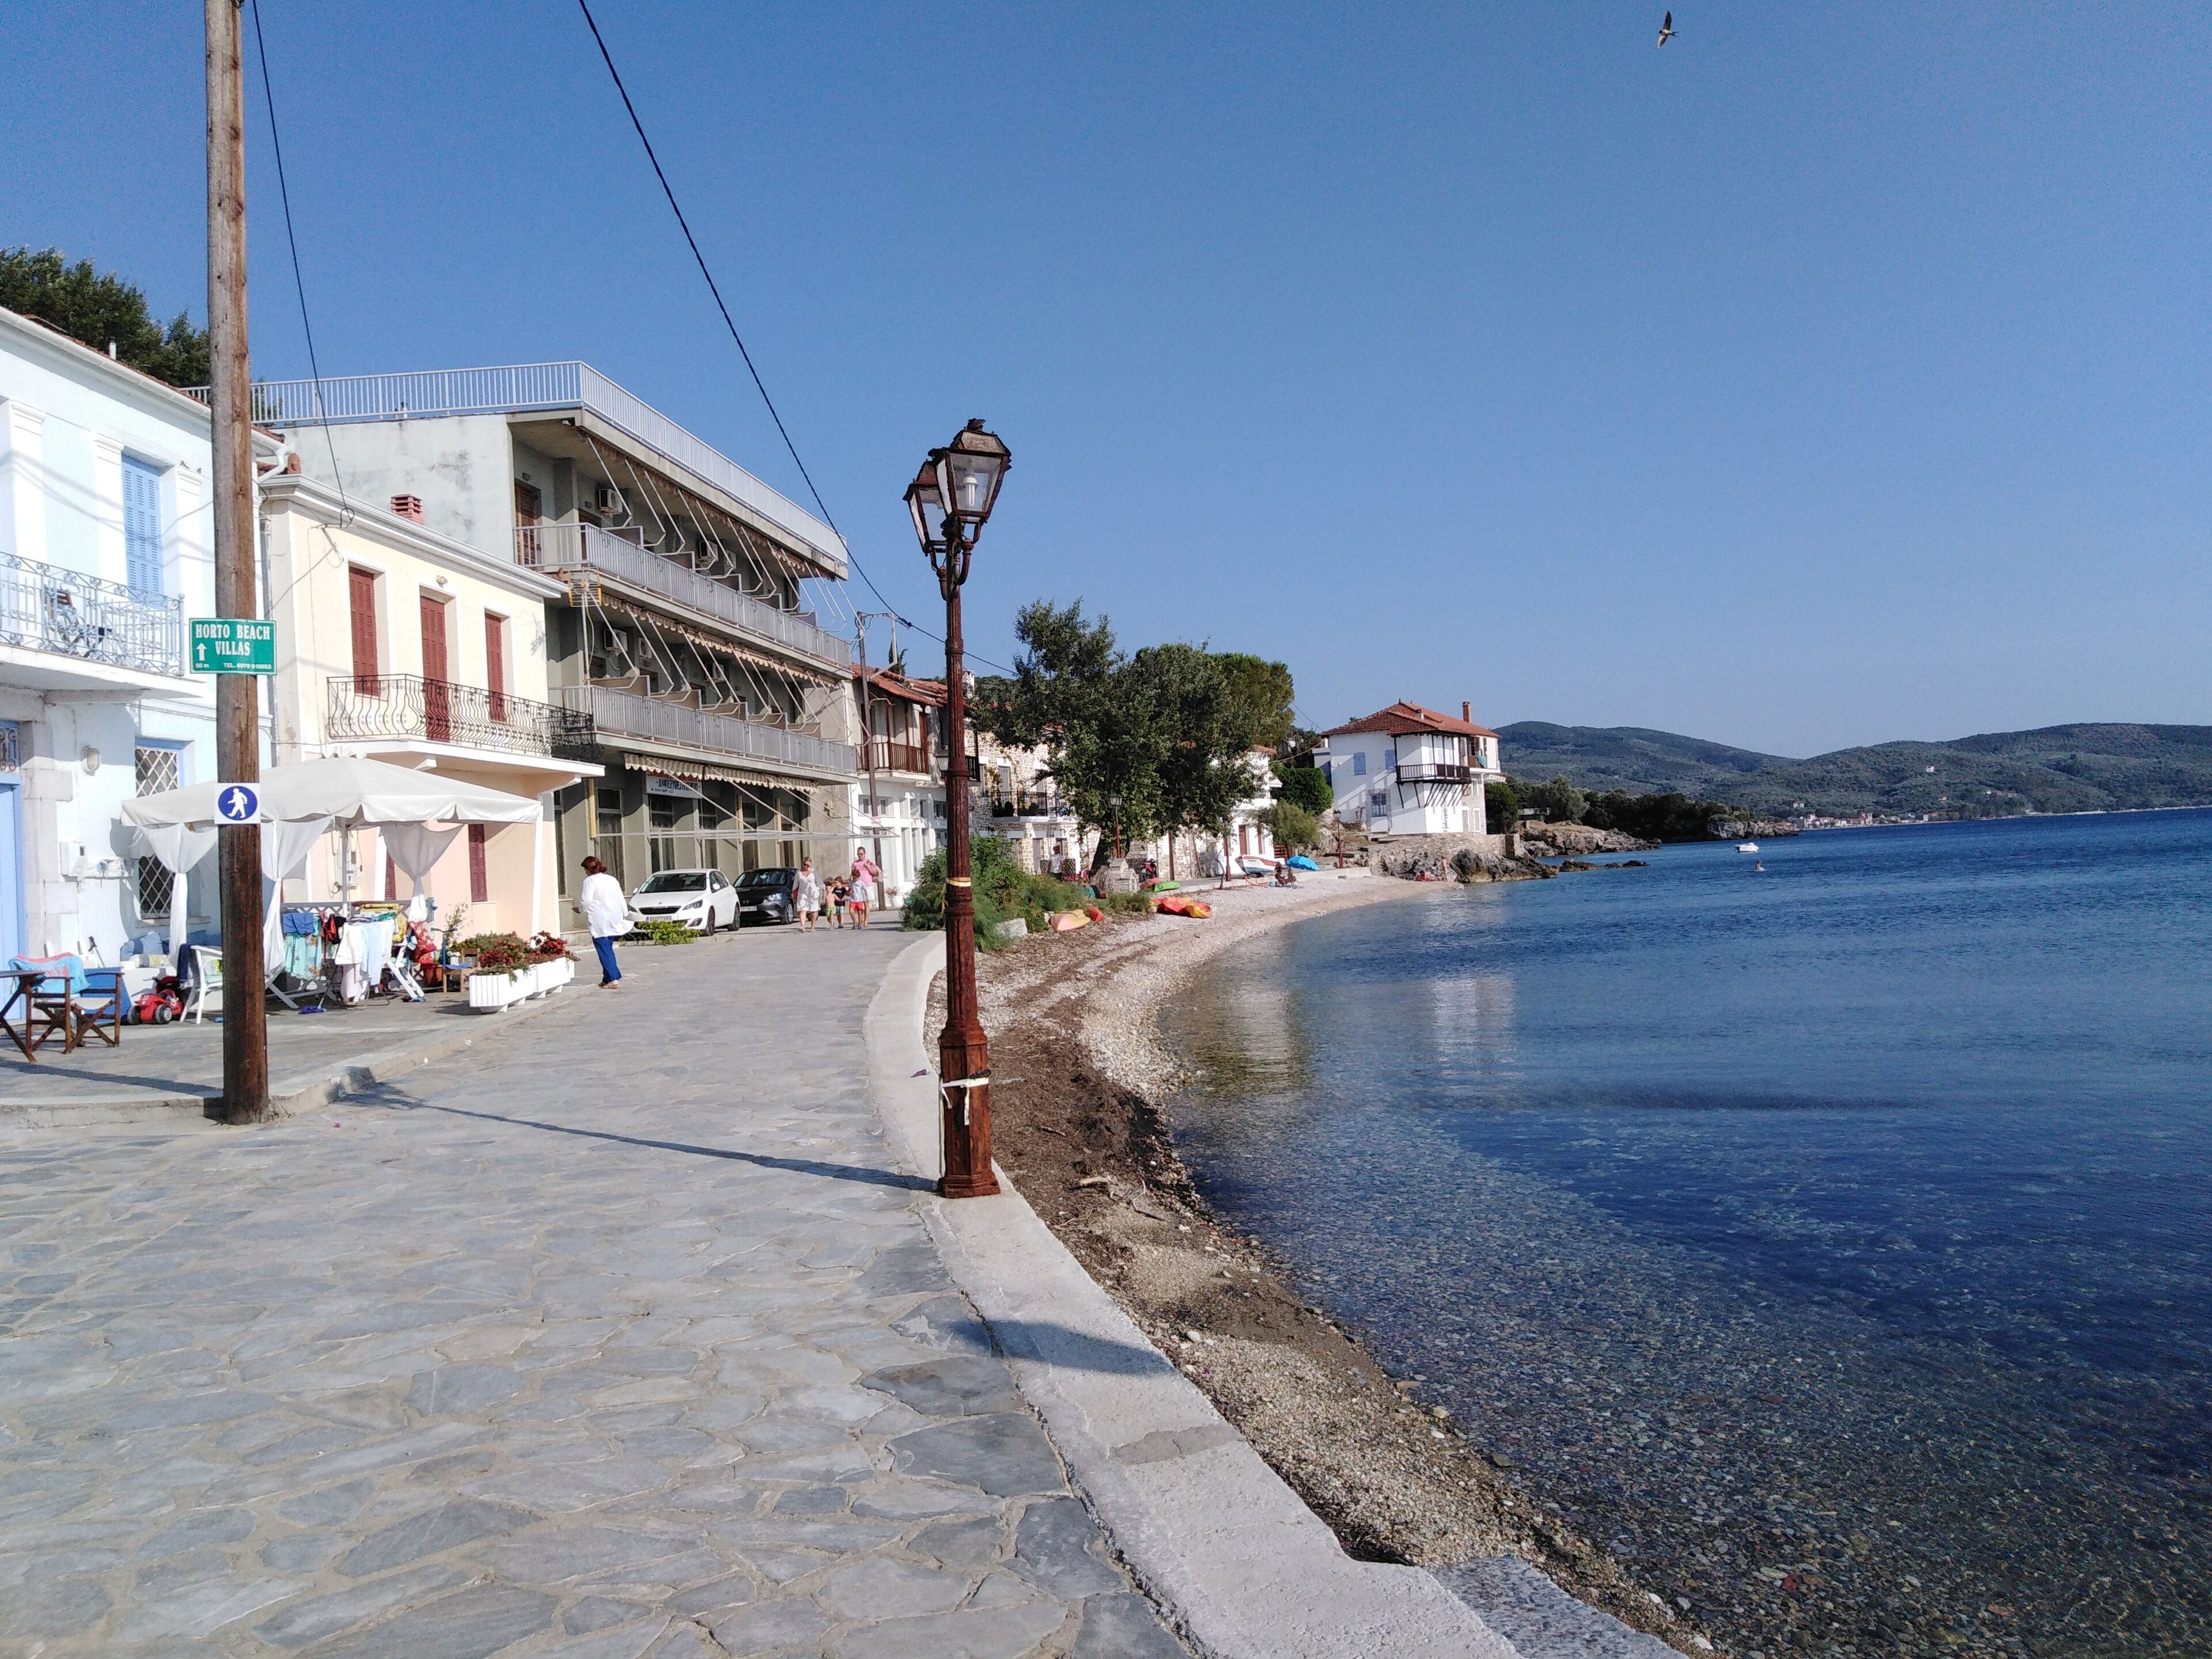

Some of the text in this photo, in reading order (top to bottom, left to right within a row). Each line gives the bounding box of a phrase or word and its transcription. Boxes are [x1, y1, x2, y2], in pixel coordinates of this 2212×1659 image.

[195, 624, 270, 640] HORTO BEACH
[215, 641, 251, 656] VILLAS
